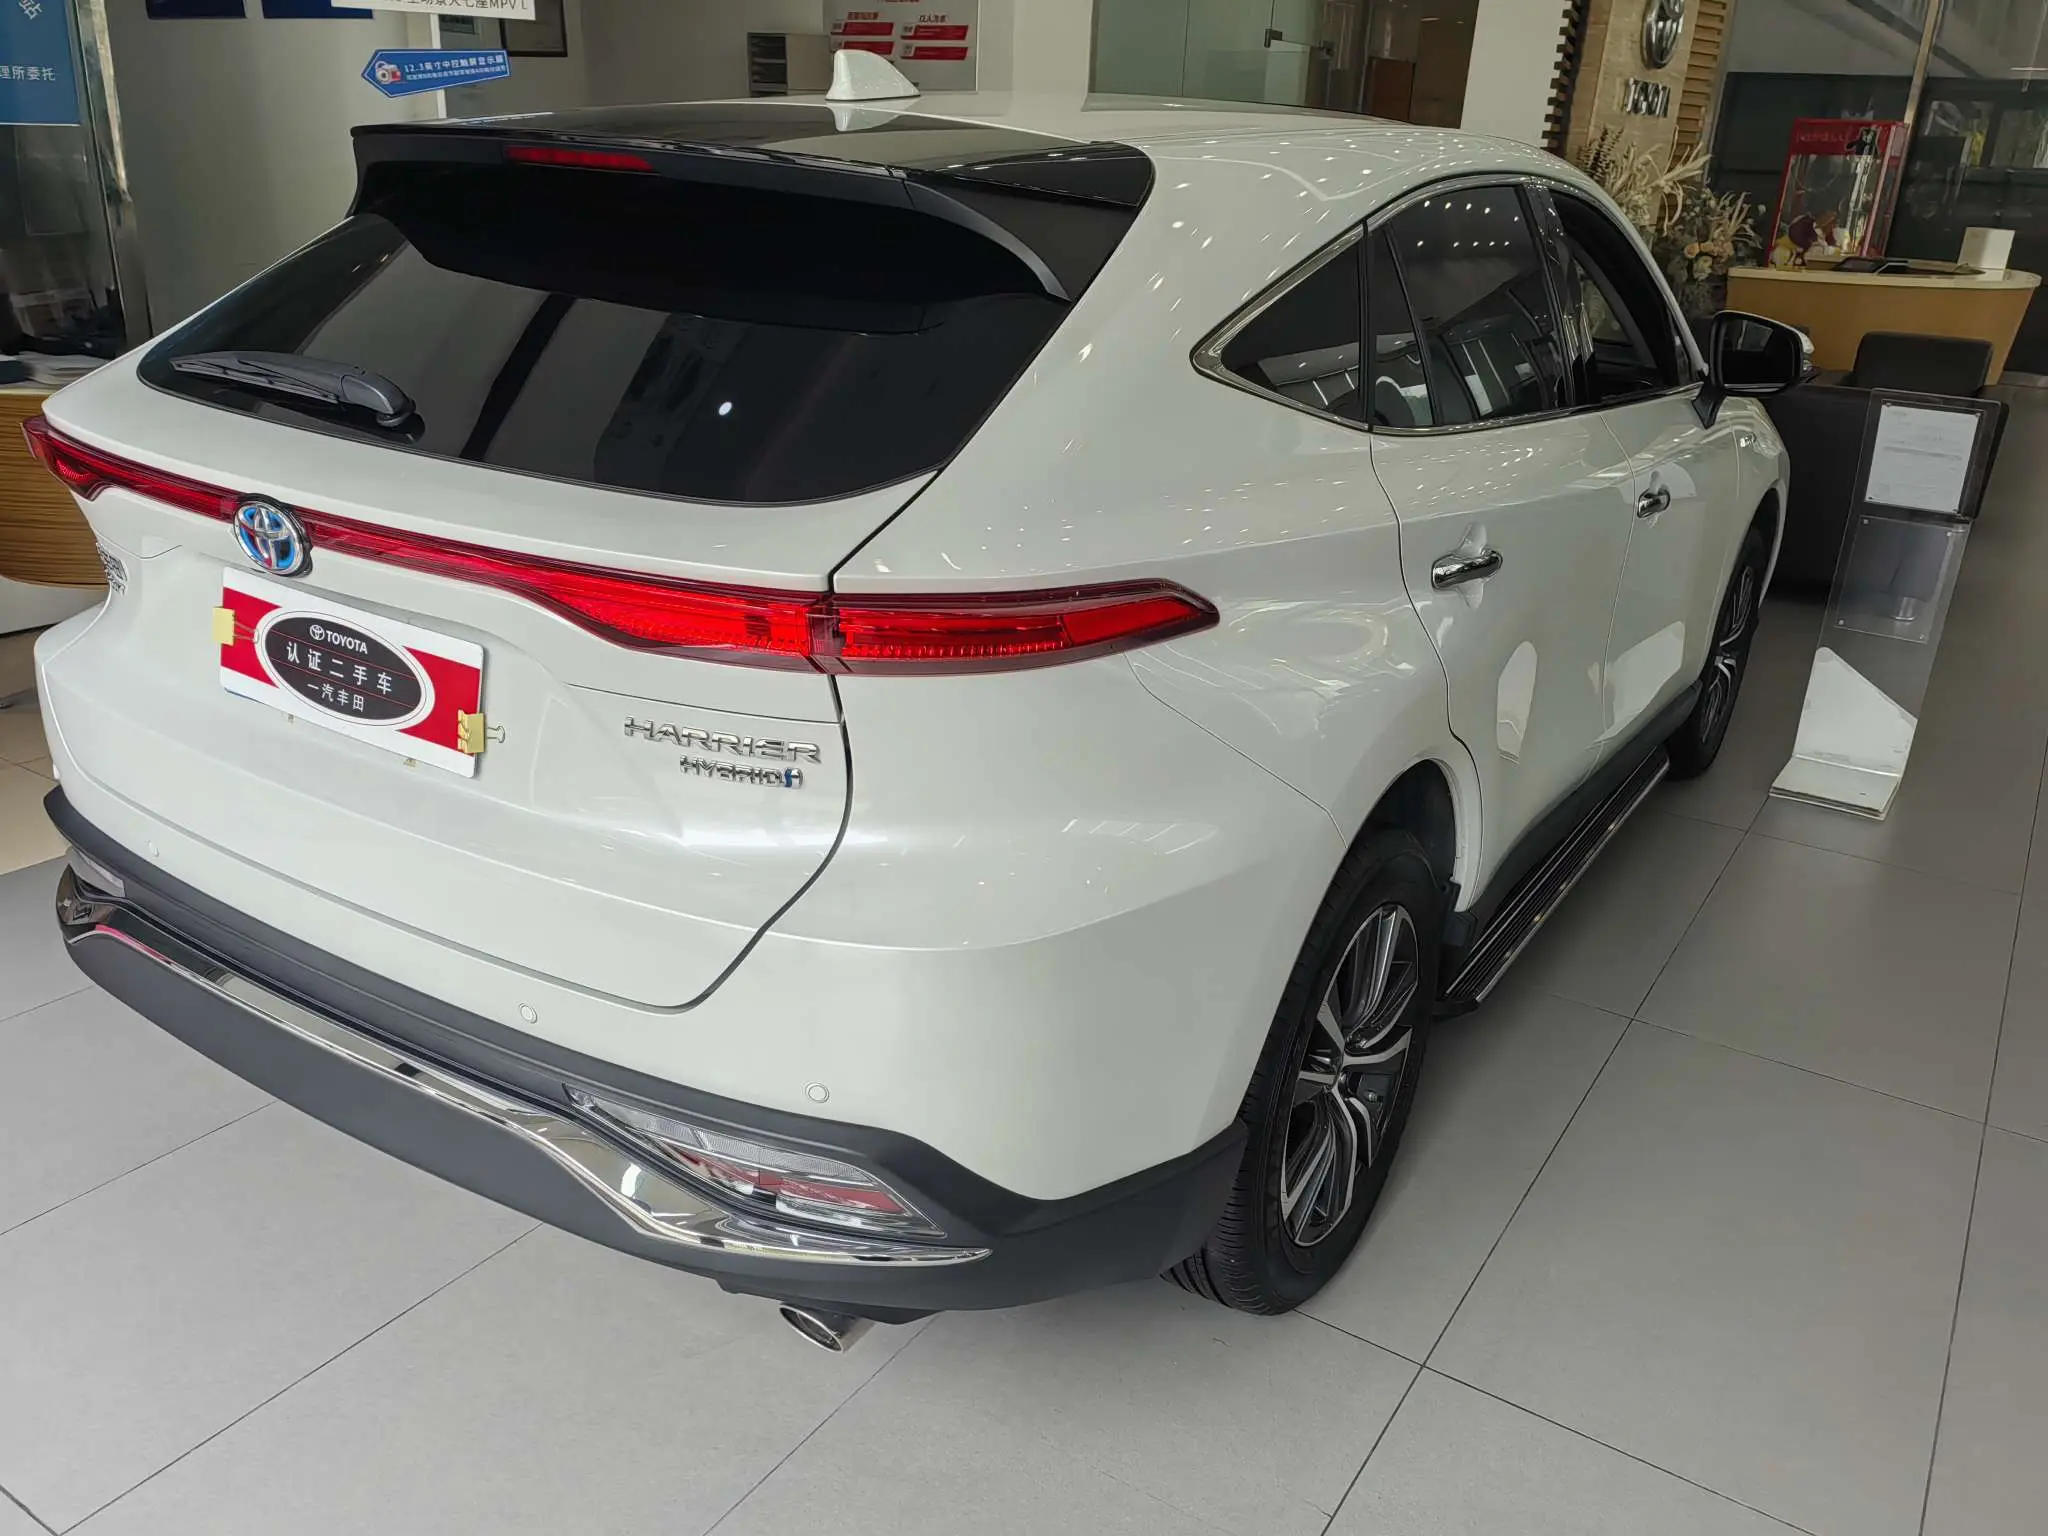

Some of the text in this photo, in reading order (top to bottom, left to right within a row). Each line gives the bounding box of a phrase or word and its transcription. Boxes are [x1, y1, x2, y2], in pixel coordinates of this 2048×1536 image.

[326, 629, 369, 655] TOYOTA
[286, 641, 393, 695] 认证二手车
[307, 682, 365, 713] 一汽丰田
[624, 715, 822, 764] HARRIER
[679, 754, 784, 788] HYBRID
